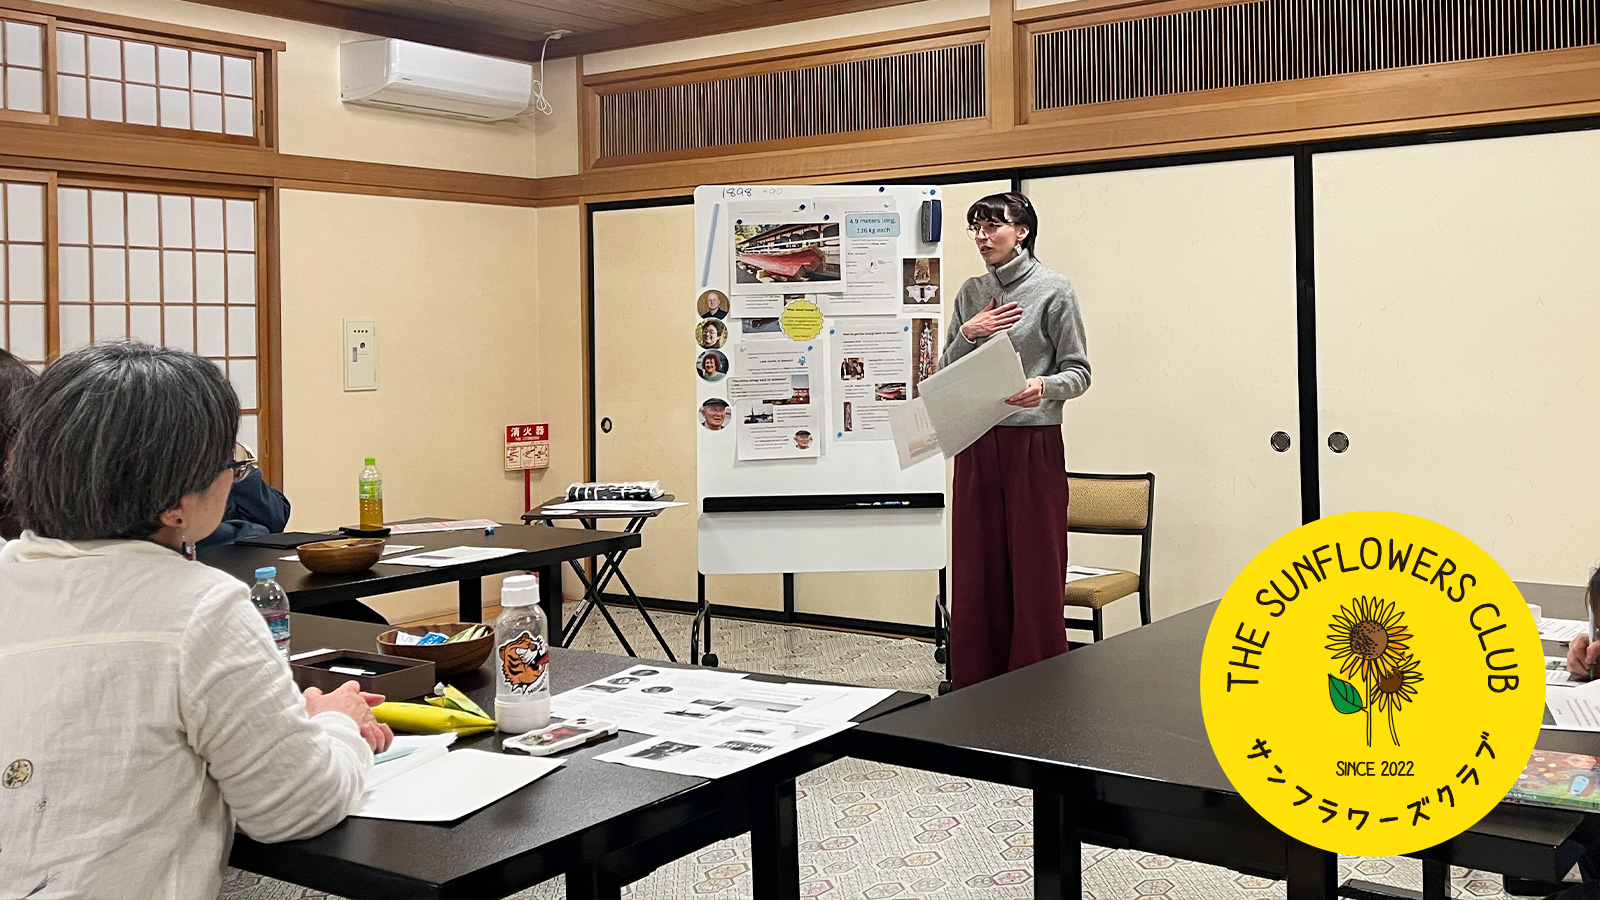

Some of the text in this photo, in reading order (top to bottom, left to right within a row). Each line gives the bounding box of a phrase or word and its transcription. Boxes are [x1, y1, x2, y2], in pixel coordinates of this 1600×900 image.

[722, 187, 752, 199] 1898
[869, 227, 876, 235] kg
[511, 425, 544, 437] 消火器
